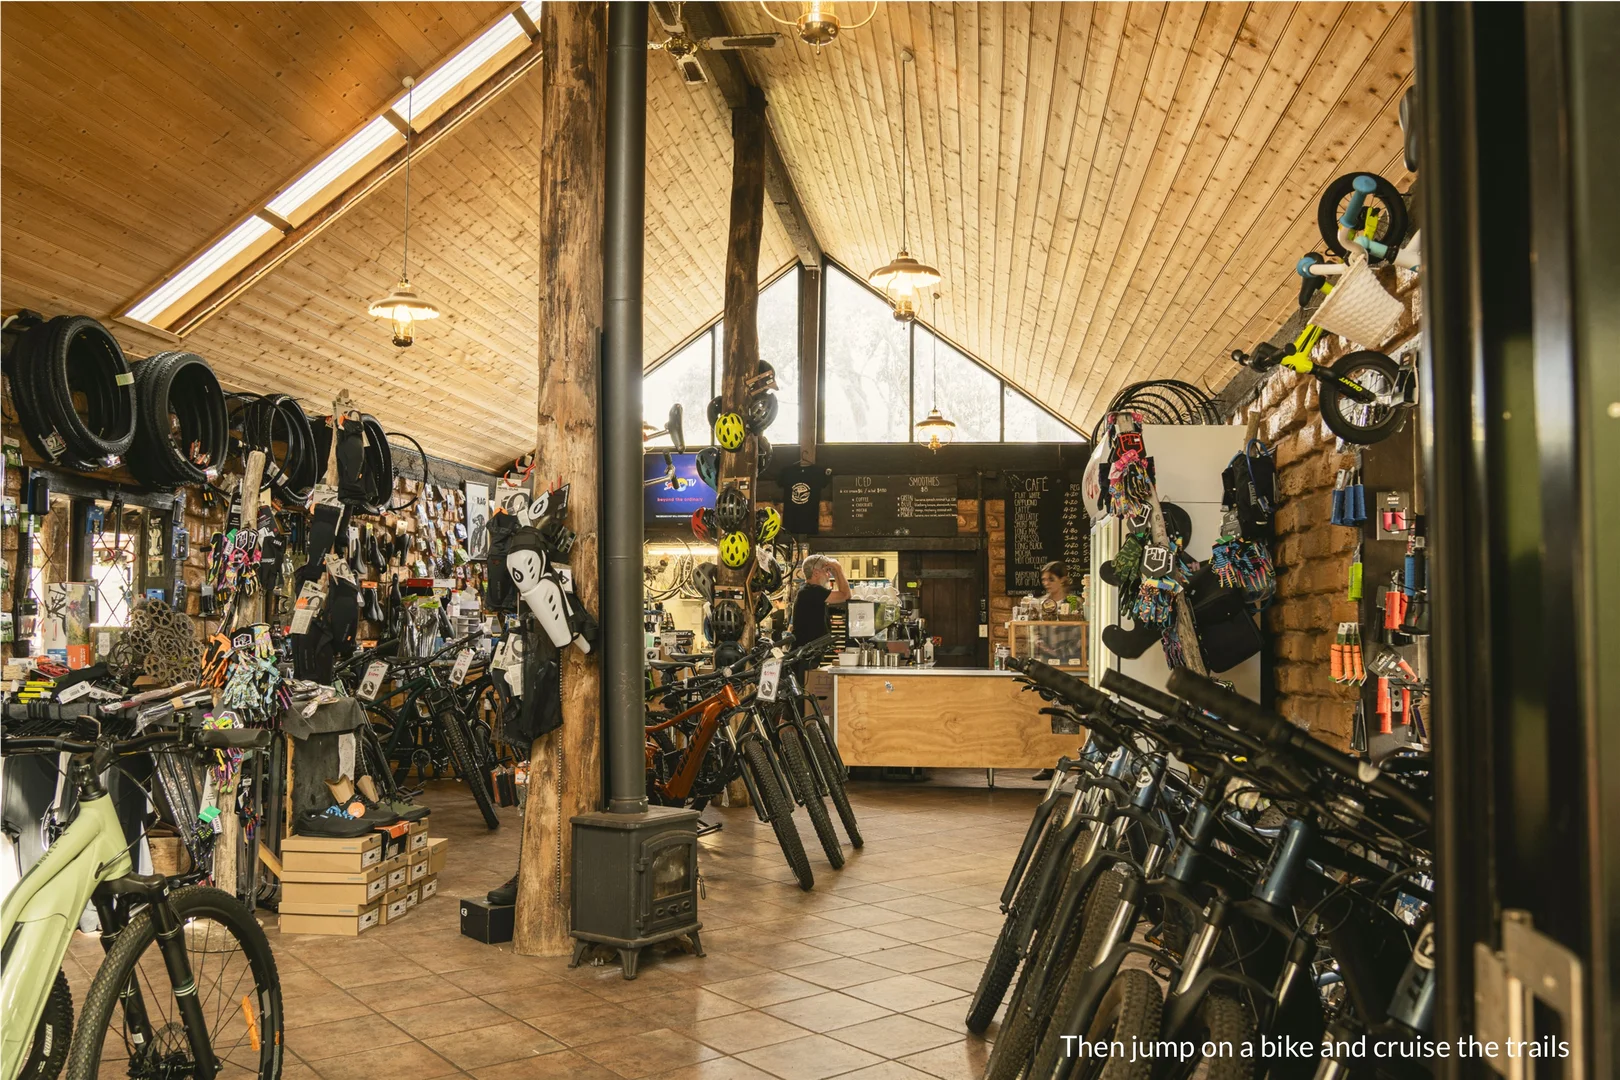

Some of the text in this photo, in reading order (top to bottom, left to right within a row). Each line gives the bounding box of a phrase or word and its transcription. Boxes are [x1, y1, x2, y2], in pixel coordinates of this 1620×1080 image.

[1338, 377, 1362, 391] GIANT
[855, 476, 872, 487] ICED
[908, 476, 940, 487] SMOOTHIES
[1025, 475, 1049, 492] CAFÉ
[1028, 491, 1041, 500] WHITE
[1014, 534, 1040, 543] ESPRESSO
[1014, 541, 1043, 550] LONG BLACK
[1024, 556, 1048, 565] CHOCOLATE
[677, 721, 703, 777] GIANT
